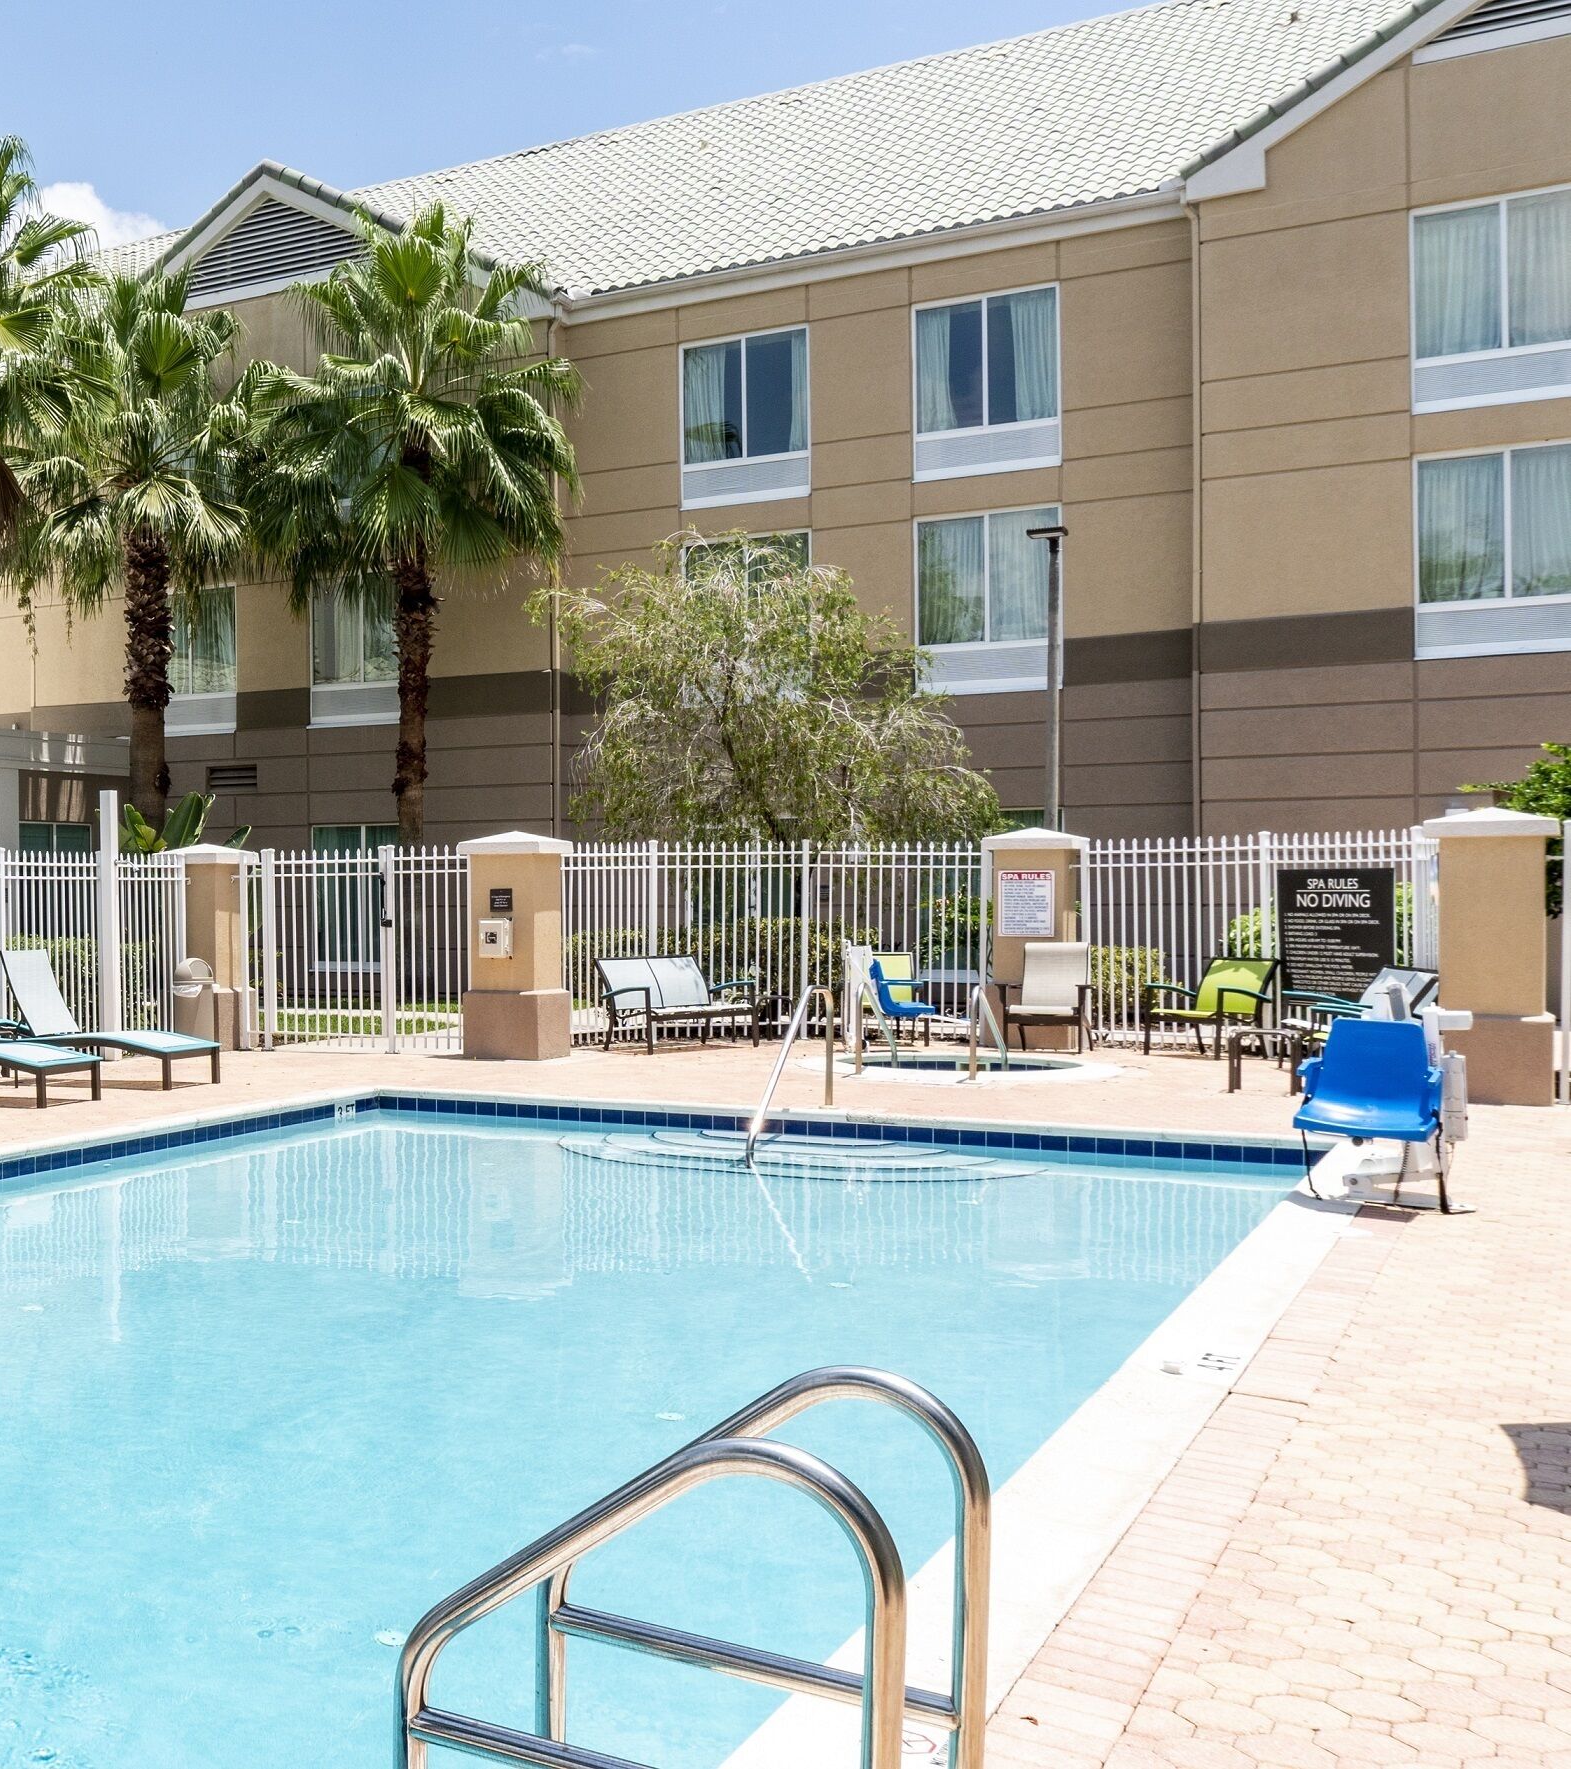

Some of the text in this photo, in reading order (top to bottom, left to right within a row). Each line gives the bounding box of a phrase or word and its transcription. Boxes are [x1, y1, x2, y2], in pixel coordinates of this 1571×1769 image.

[1307, 878, 1359, 889] SPA RULES
[1296, 894, 1371, 907] NO DIVING
